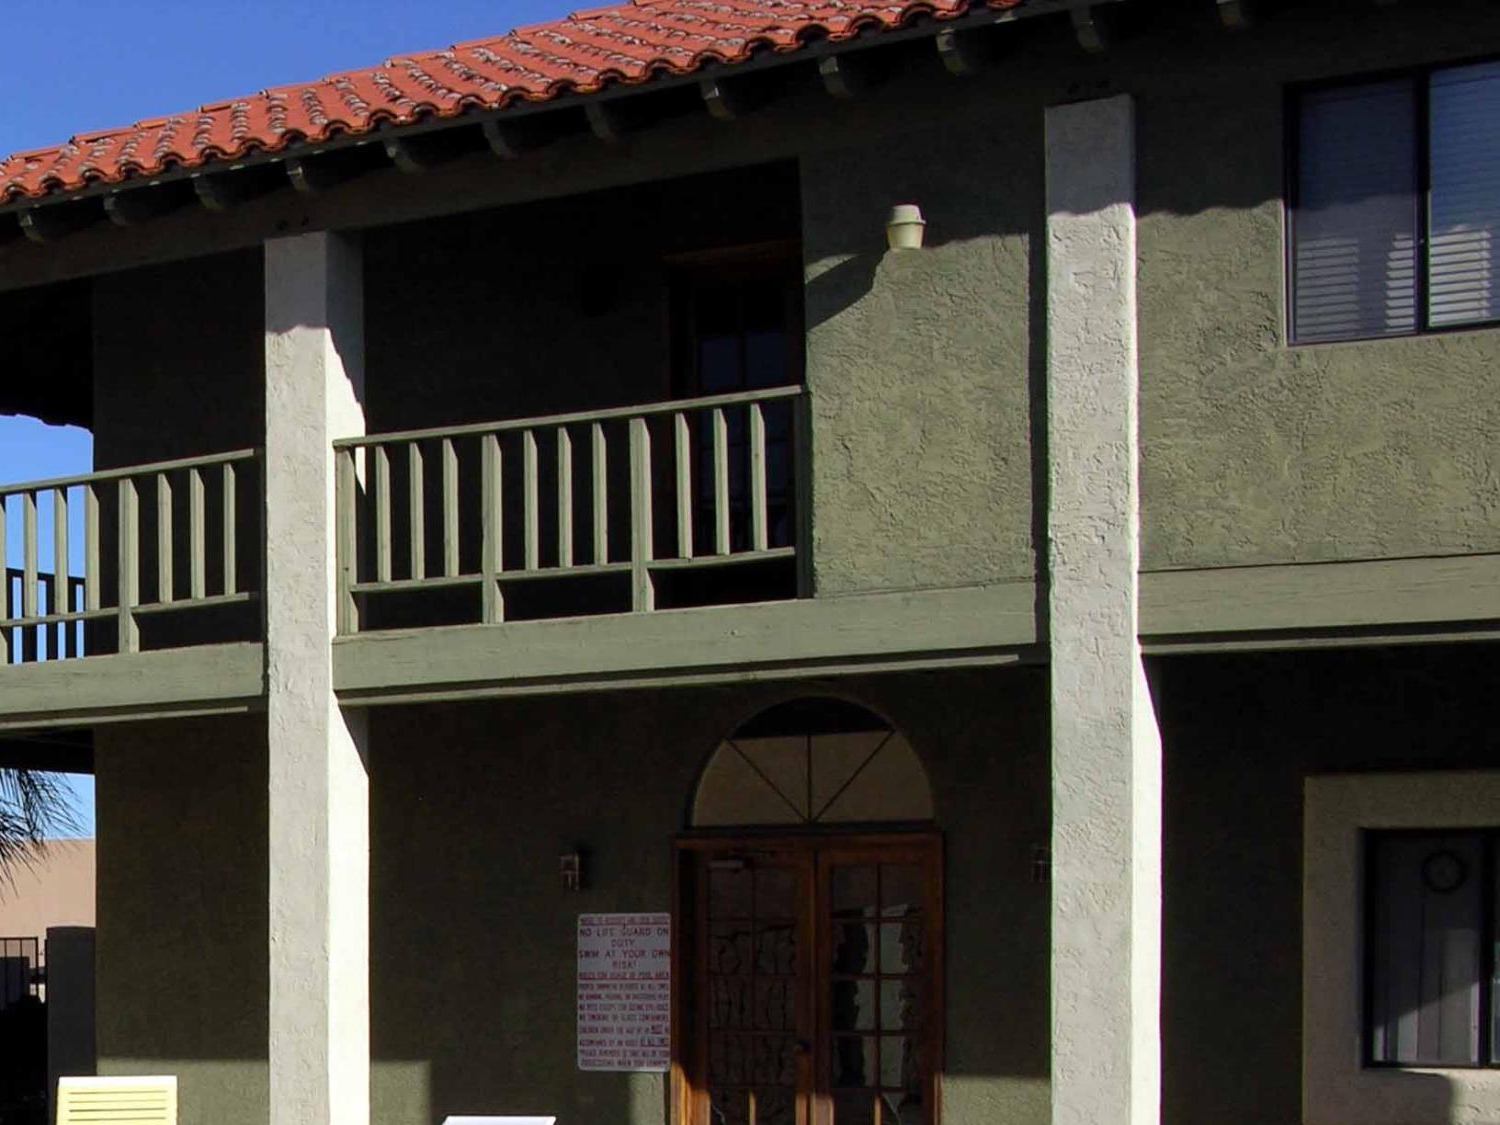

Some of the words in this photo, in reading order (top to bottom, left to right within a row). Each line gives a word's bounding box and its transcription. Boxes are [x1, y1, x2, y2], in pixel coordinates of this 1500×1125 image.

[580, 927, 592, 937] NO
[657, 927, 669, 937] ON
[611, 938, 636, 948] DUTY
[621, 950, 646, 959] YOUR
